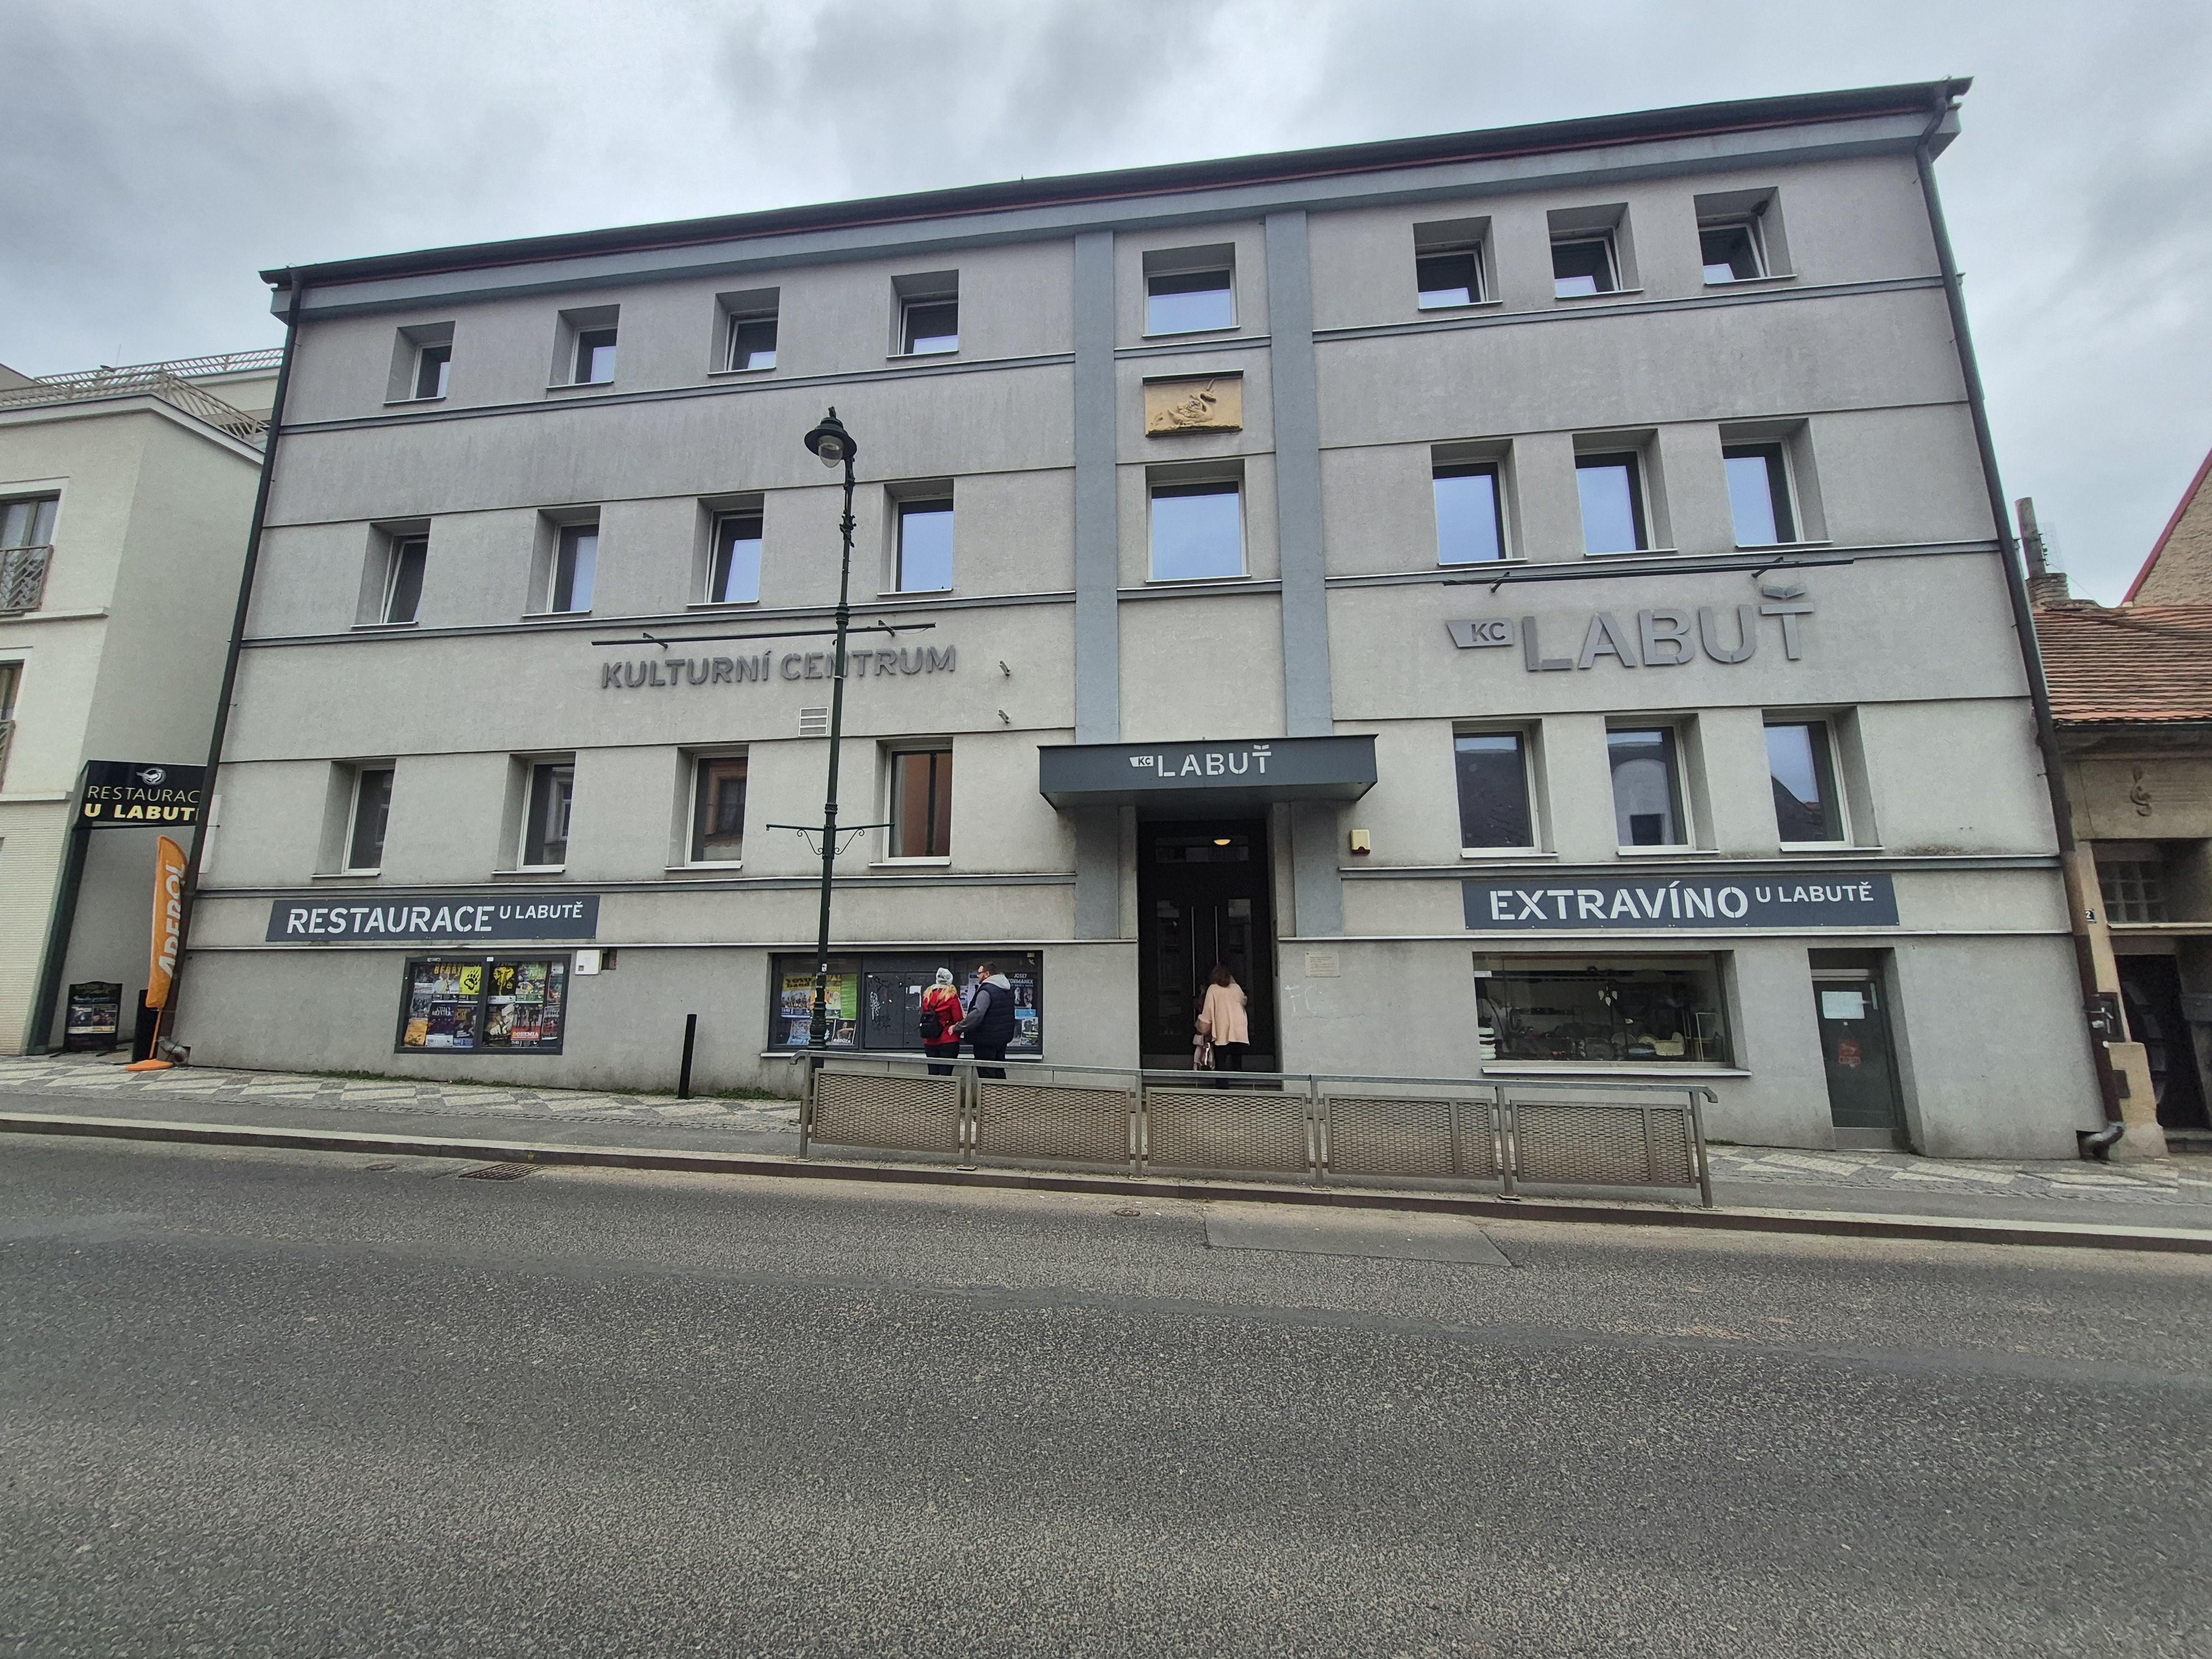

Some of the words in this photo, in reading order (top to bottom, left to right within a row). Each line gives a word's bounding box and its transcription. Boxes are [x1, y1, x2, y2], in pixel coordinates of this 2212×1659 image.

[1470, 621, 1506, 643] KC
[1522, 584, 1815, 672] LABUŤ
[601, 648, 772, 688] KULTURNÍ
[780, 645, 956, 681] CENTRUM
[1138, 757, 1151, 766] KC
[1157, 744, 1272, 777] LABUŤ
[84, 803, 102, 817] U
[114, 804, 199, 821] LABUT
[286, 905, 495, 934] RESTAURACE
[499, 905, 512, 920] U
[515, 901, 583, 919] LABUTĚ
[1489, 880, 1749, 920] EXTRAVÍNO
[1755, 886, 1771, 903] U
[1778, 881, 1874, 902] LABUTĚ
[159, 863, 185, 978] APEROL
